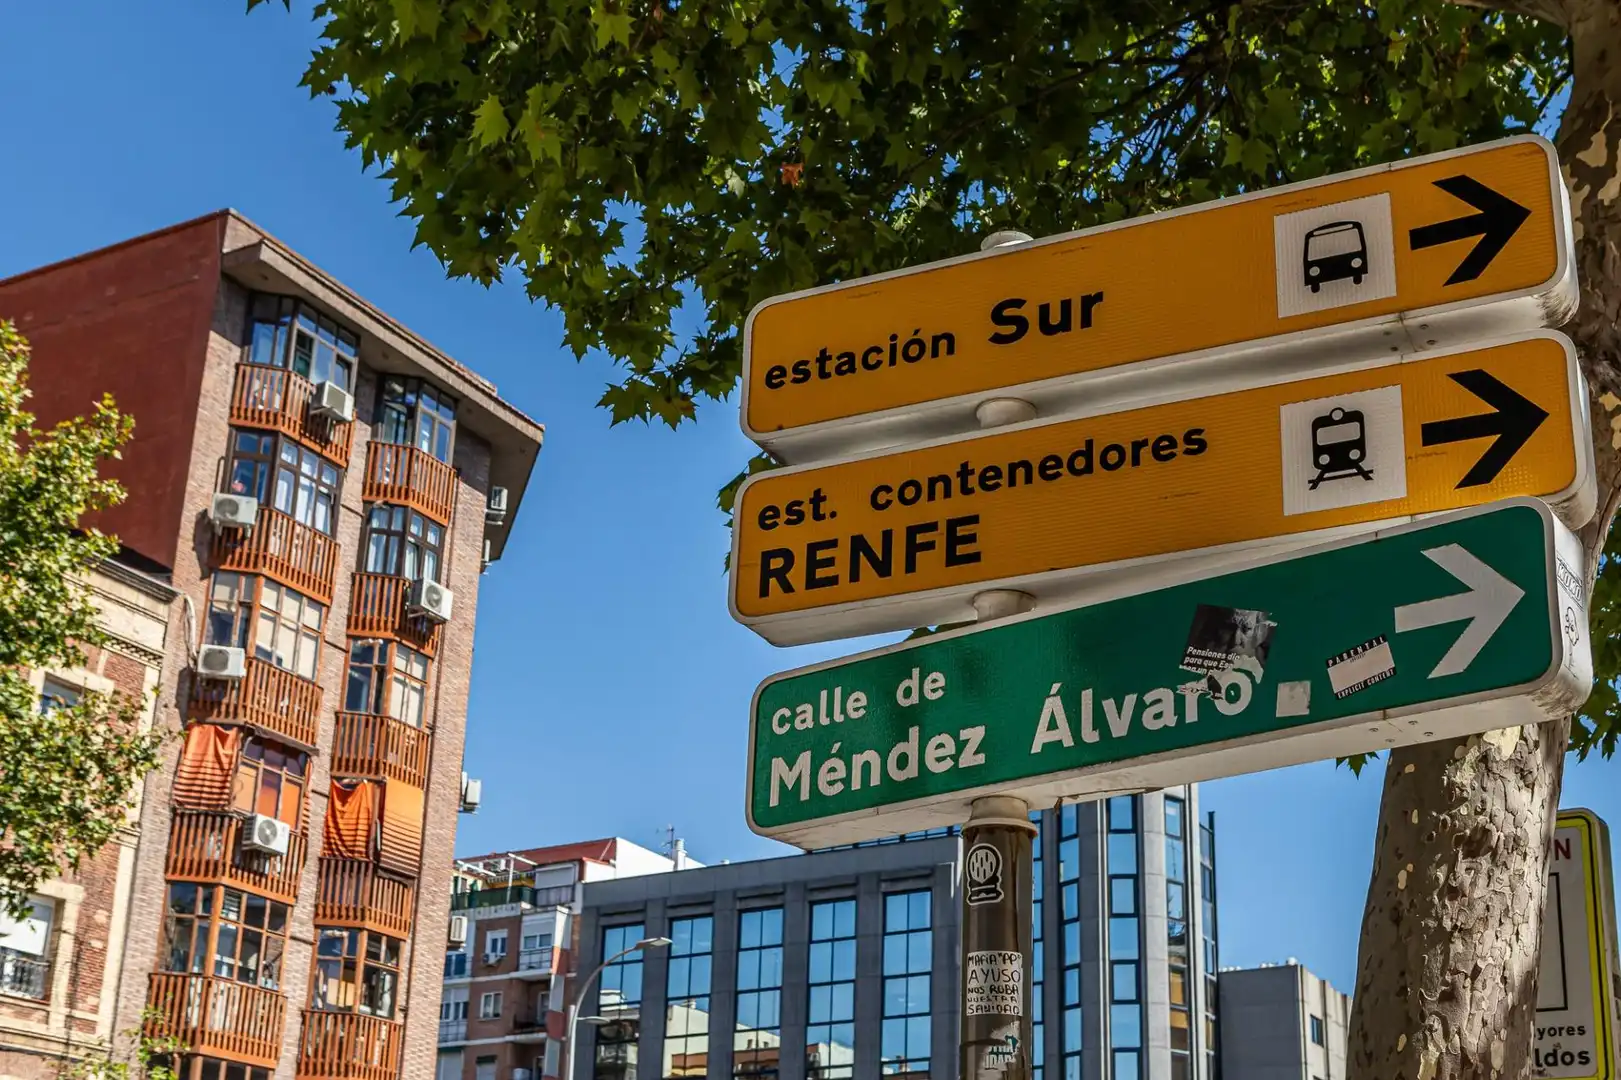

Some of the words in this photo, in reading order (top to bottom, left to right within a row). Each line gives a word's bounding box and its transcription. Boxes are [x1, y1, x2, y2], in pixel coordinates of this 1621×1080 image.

[764, 328, 956, 390] estación
[988, 291, 1104, 345] Sur
[757, 487, 838, 532] est.
[869, 427, 1209, 512] contenedores
[758, 514, 983, 599] RENFE
[1183, 656, 1203, 666] para
[1187, 646, 1227, 660] Pensiones
[1327, 636, 1385, 668] PARENTAL
[1337, 681, 1365, 699] EXPLICIT
[1367, 668, 1395, 686] CONTENT
[771, 685, 867, 735] calle
[895, 666, 946, 707] de
[769, 722, 987, 808] Méndez
[1030, 670, 1253, 755] Álvaro
[967, 986, 985, 995] NOS
[968, 967, 1021, 984] AYUSO
[1533, 1025, 1586, 1041] yores
[1533, 1047, 1591, 1068] ldos
